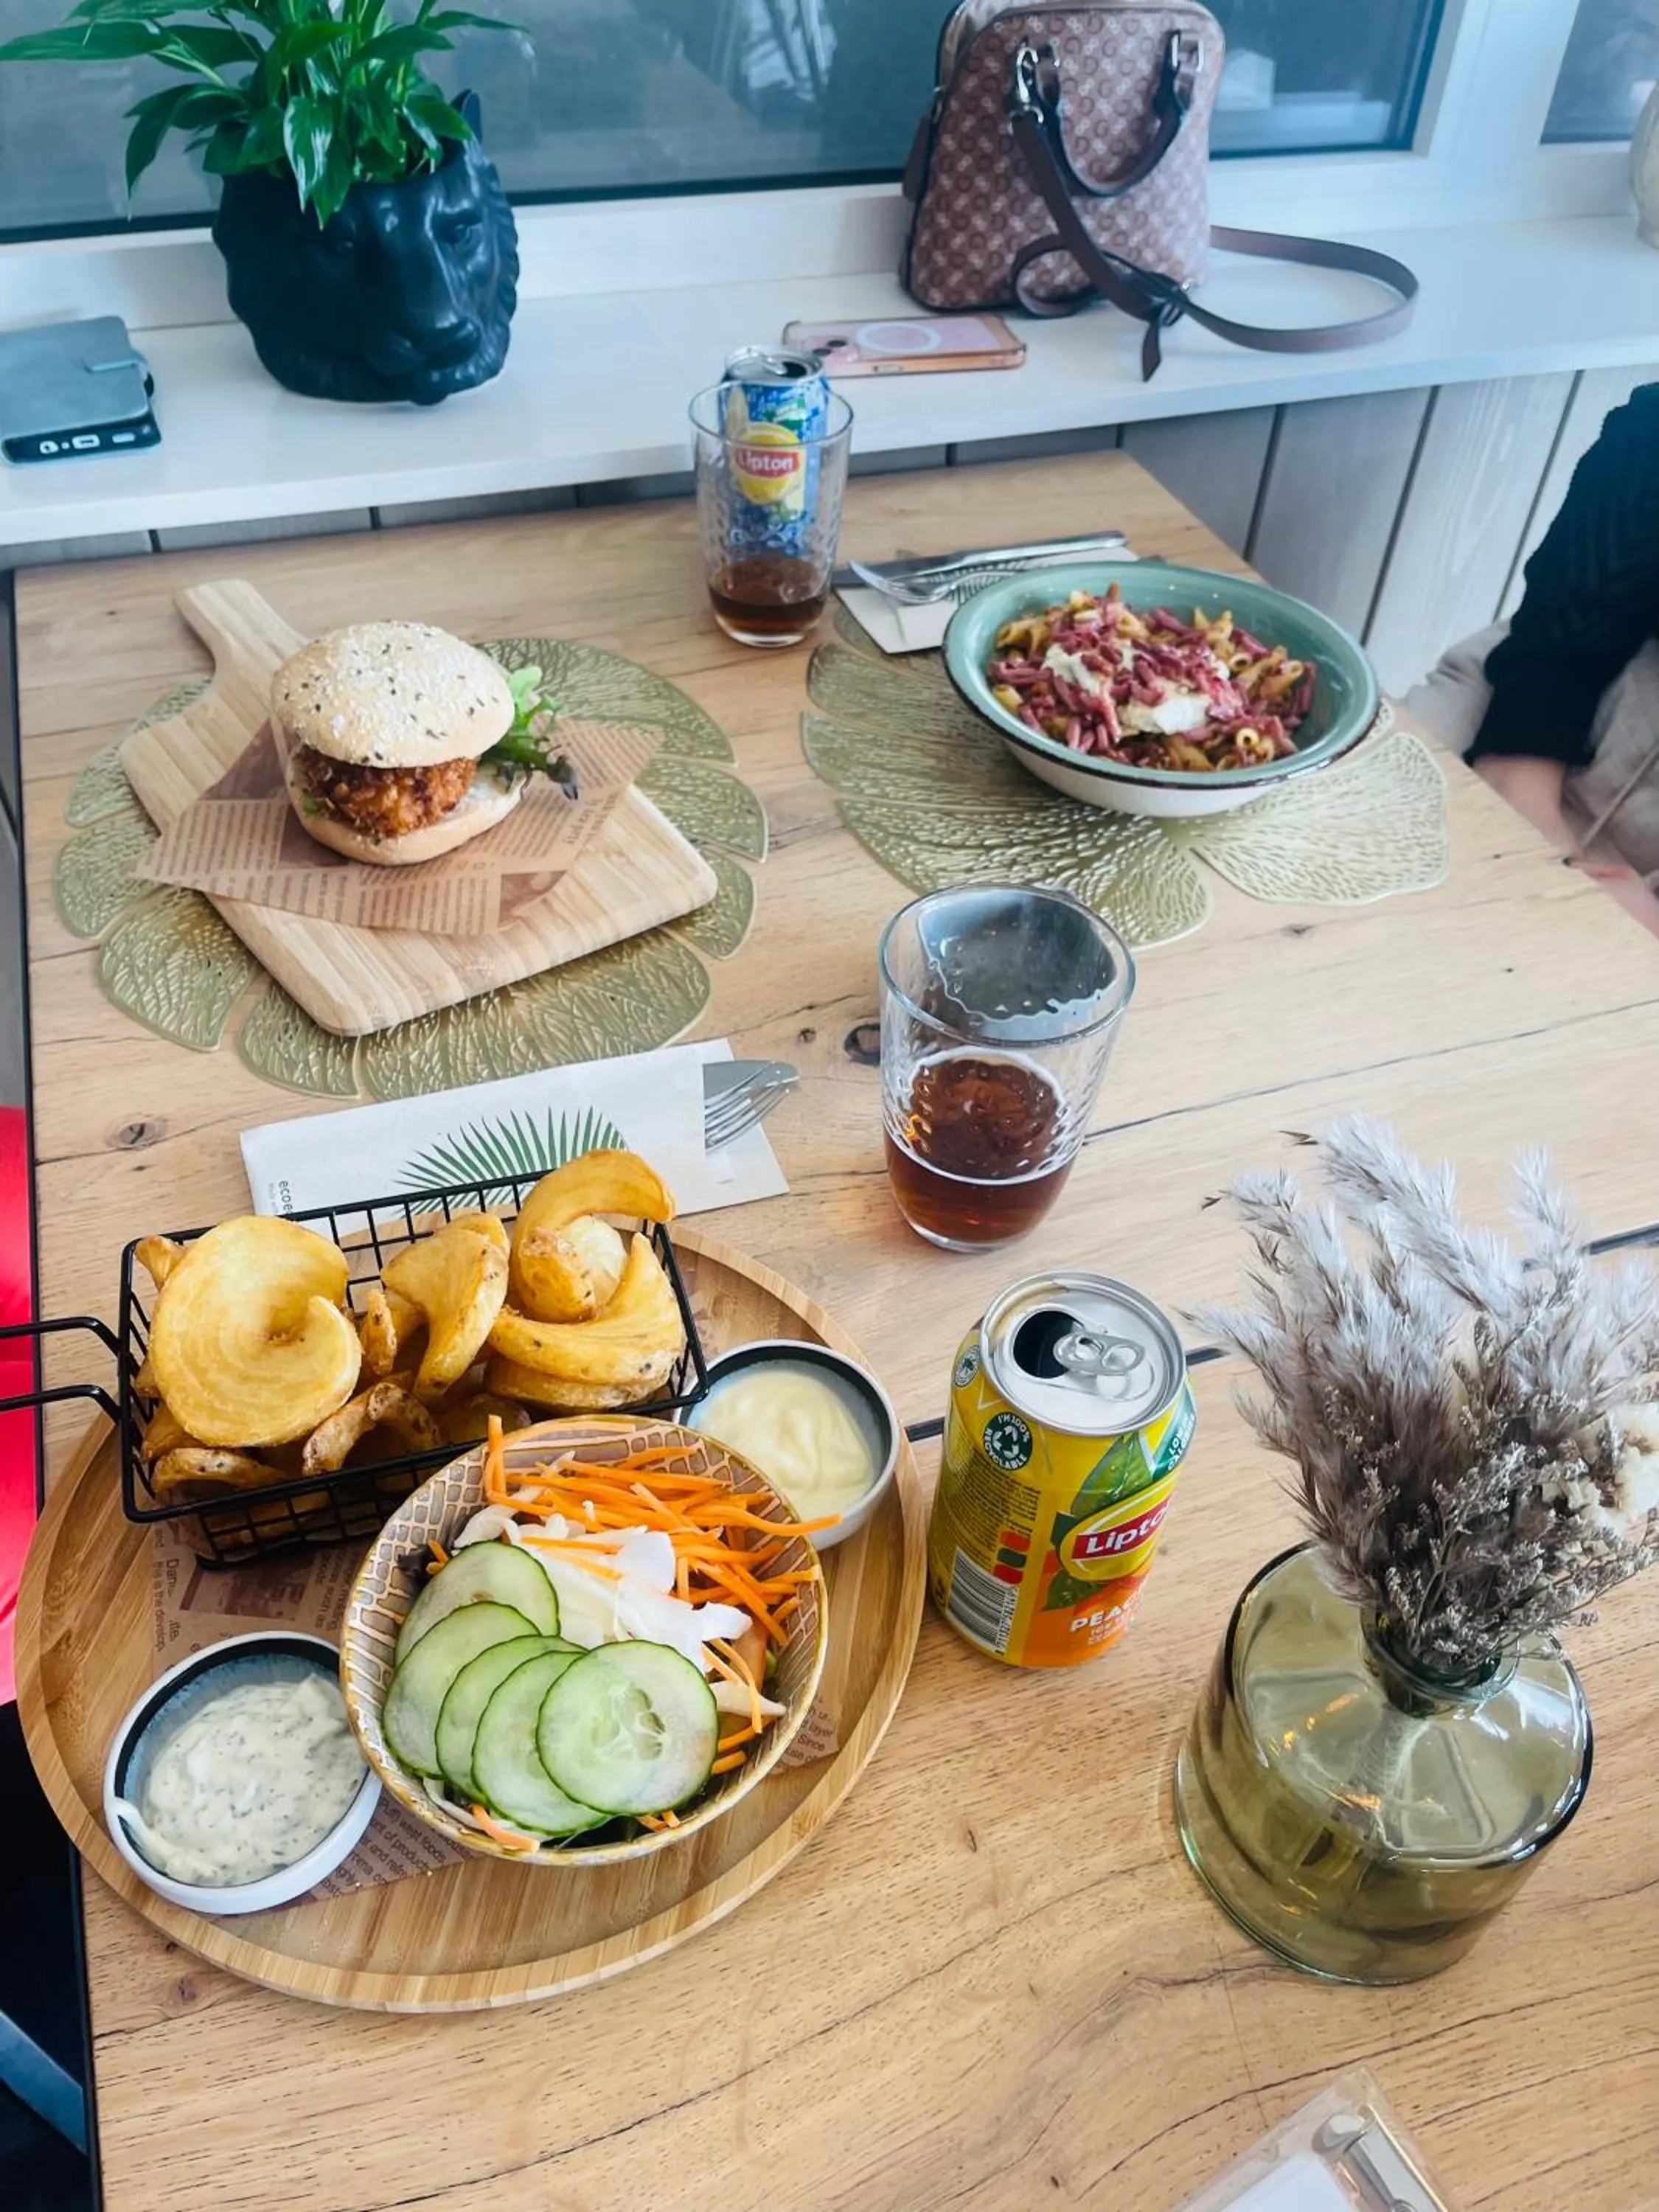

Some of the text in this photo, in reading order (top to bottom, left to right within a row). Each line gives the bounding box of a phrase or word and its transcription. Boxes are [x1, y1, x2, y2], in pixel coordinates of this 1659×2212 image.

[738, 450, 793, 471] Lipton
[279, 1180, 293, 1214] ecoe
[984, 1427, 1027, 1470] RECYCLABLE
